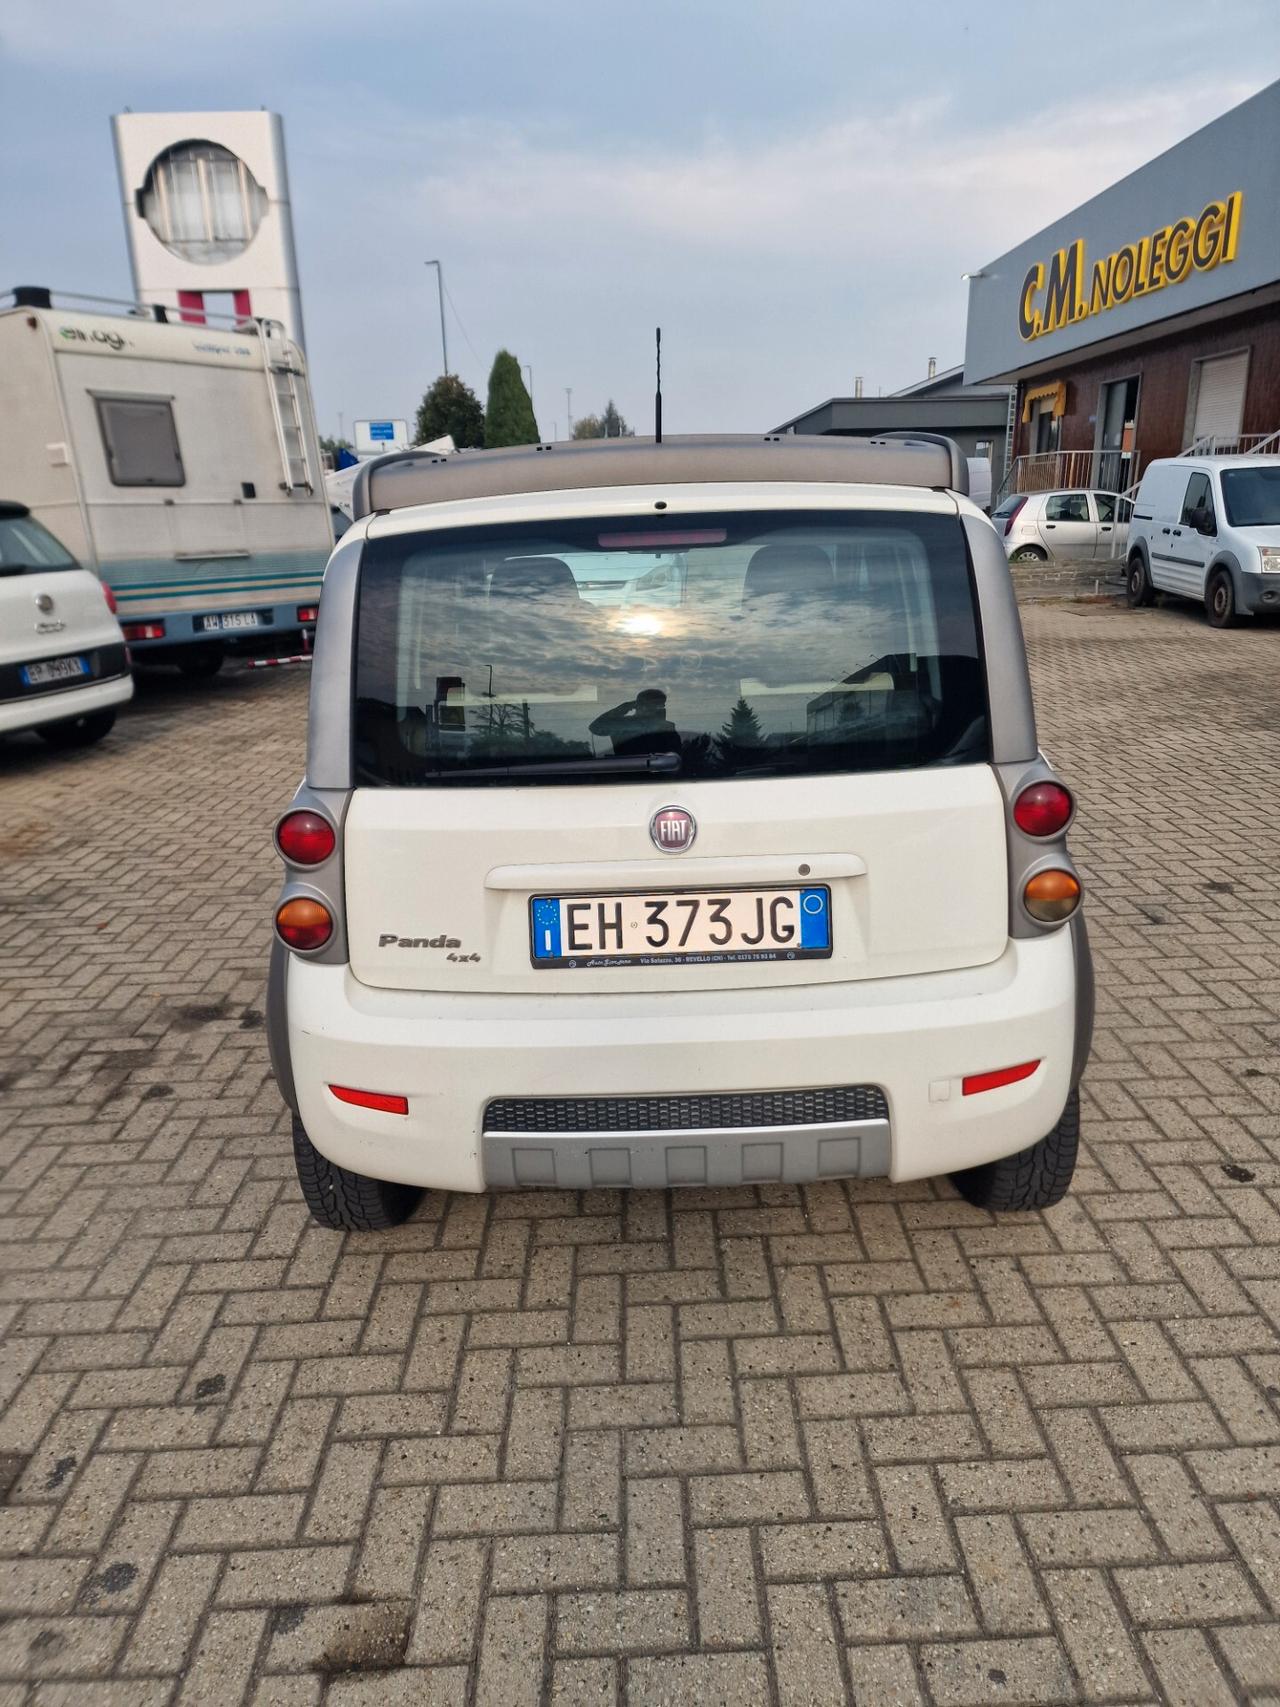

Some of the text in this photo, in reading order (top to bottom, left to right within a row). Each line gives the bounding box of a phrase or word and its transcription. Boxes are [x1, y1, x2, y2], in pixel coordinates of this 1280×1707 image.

[1018, 191, 1243, 341] C.M. NOLEGGI
[660, 819, 687, 841] FIAT
[544, 929, 552, 951] I
[566, 901, 624, 951] EH
[378, 933, 462, 949] Panda
[446, 952, 482, 963] 4x4
